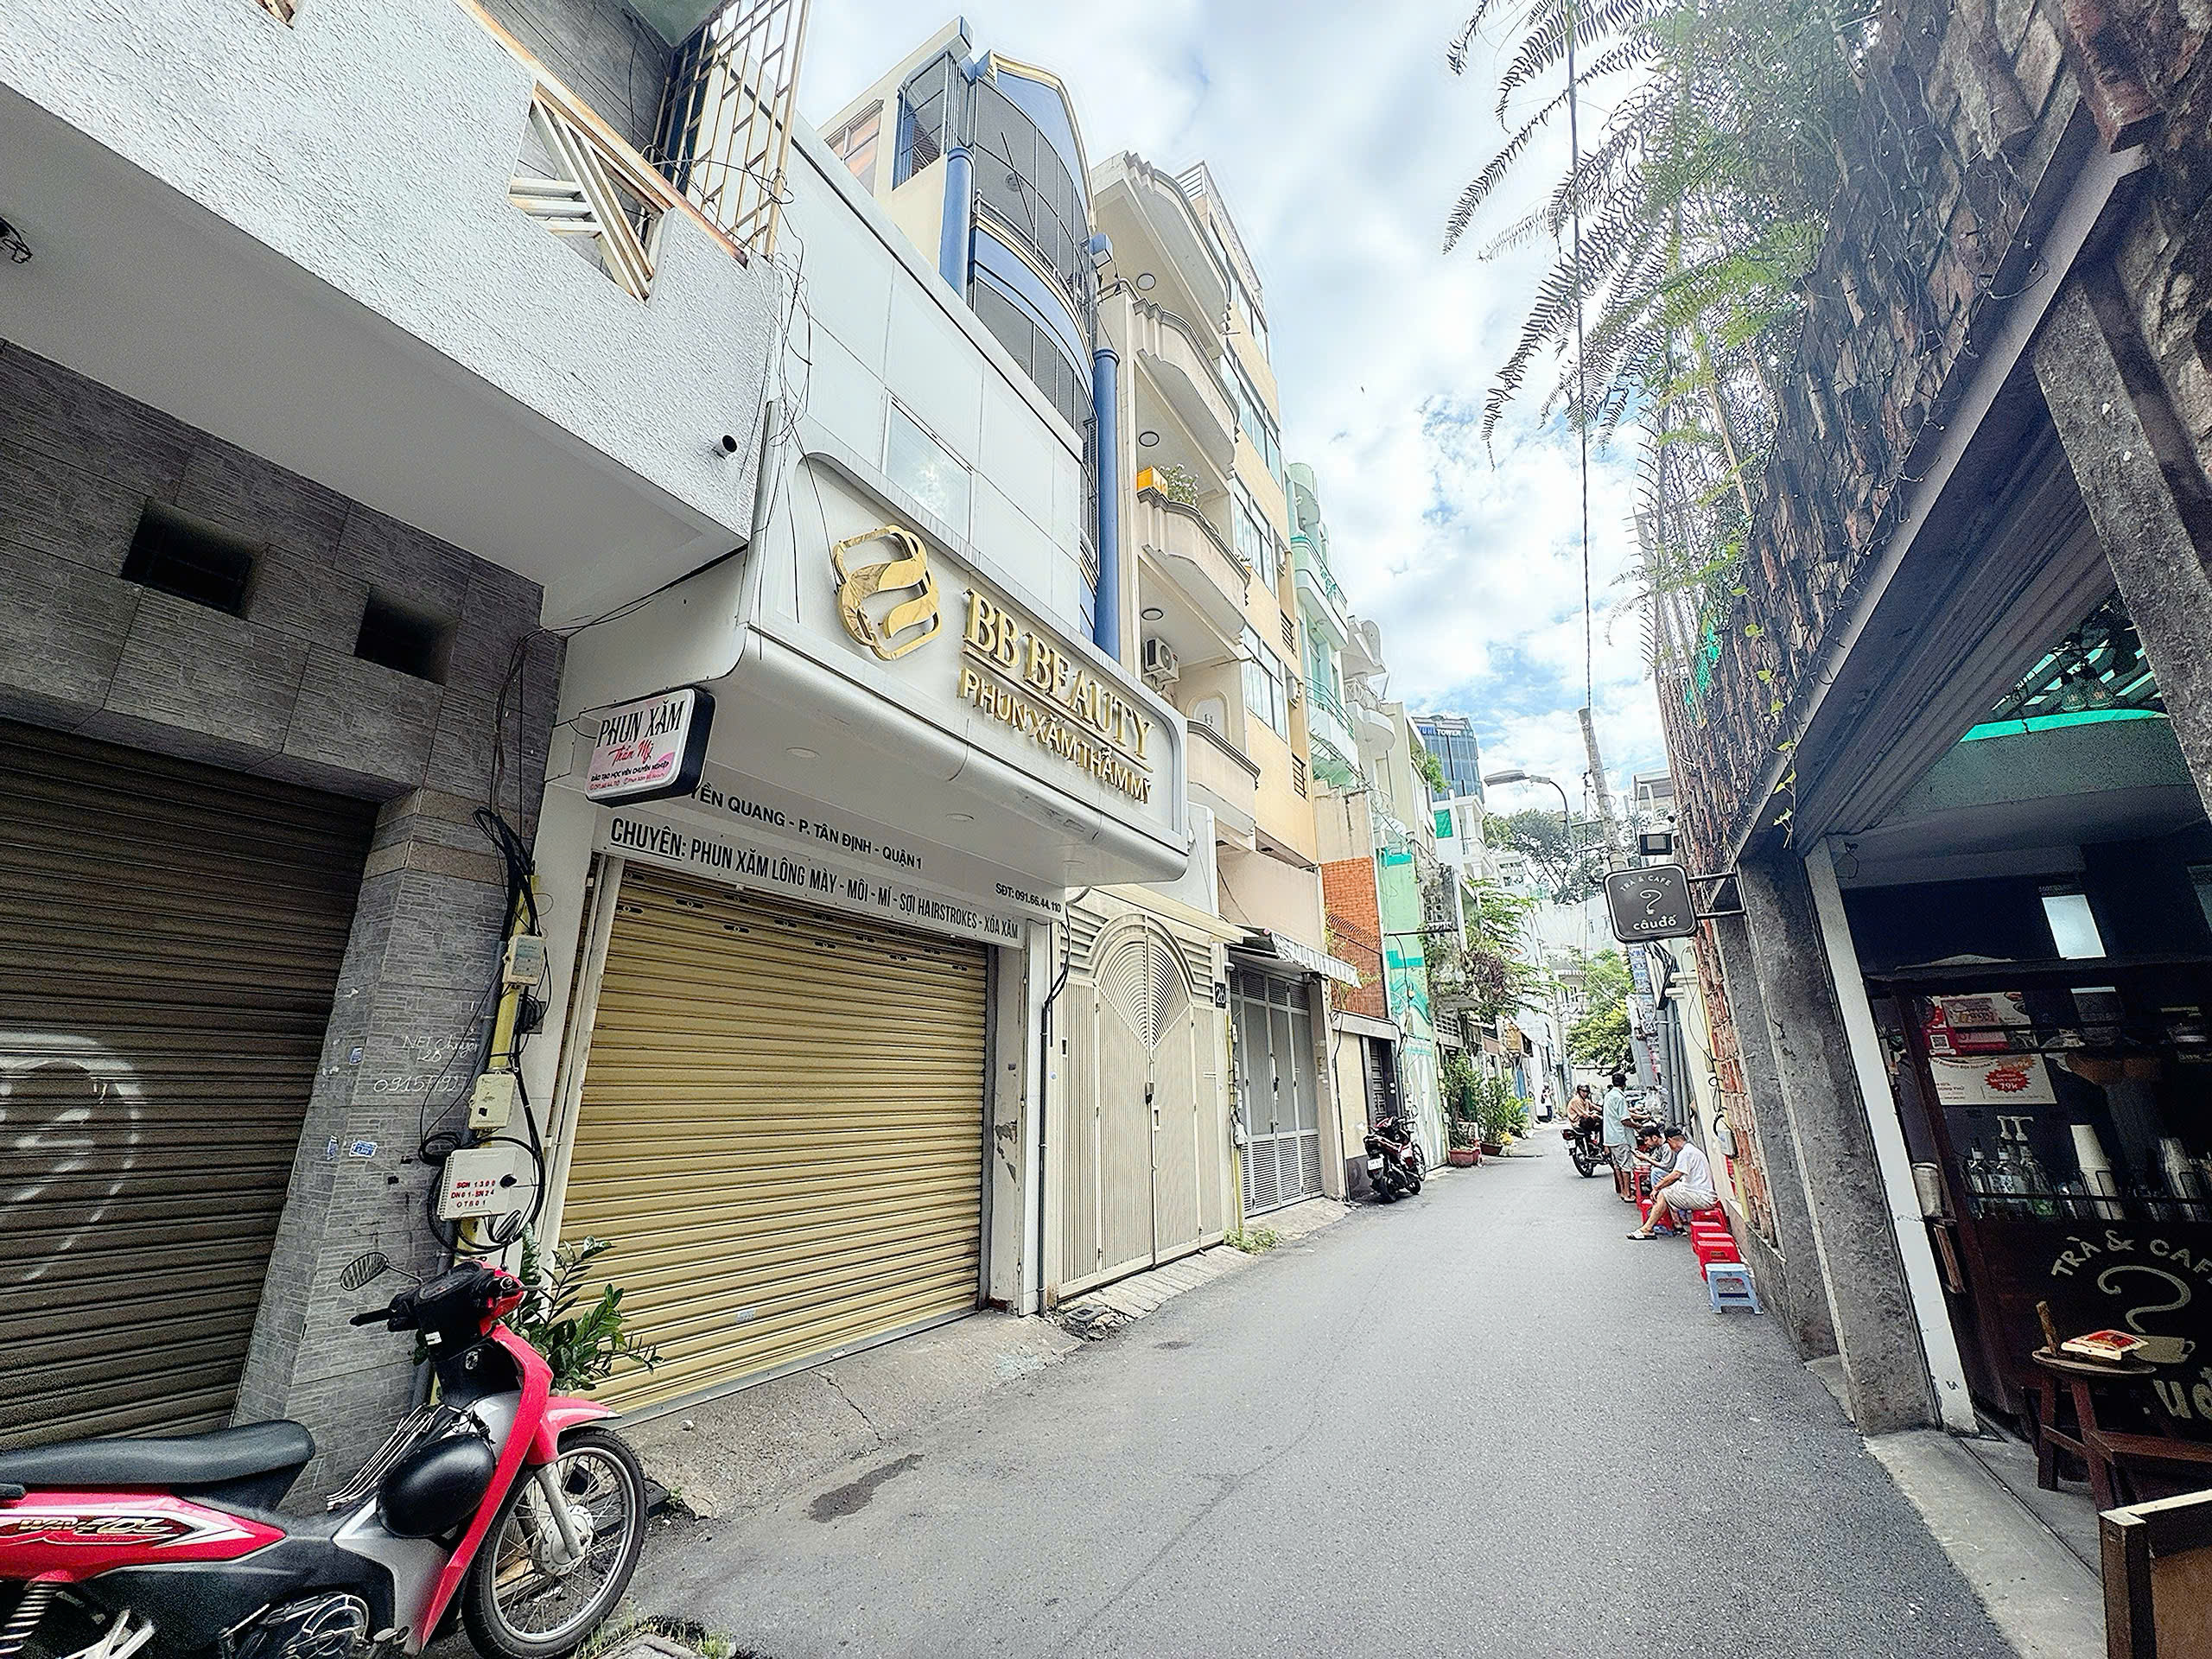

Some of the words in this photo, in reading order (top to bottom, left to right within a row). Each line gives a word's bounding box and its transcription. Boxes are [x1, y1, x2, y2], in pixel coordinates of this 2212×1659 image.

[963, 588, 1020, 669] BB
[1024, 631, 1155, 760] BEAUTY
[596, 711, 644, 748] PHUN
[645, 700, 685, 737] XĂM
[957, 667, 1028, 732] PHUN
[1028, 709, 1078, 762] XĂM
[728, 797, 785, 828] QUANG
[798, 819, 810, 835] P.
[813, 823, 839, 844] TÂN
[842, 836, 872, 855] ĐỊNH
[882, 846, 915, 868] QUẬN
[611, 817, 686, 858] CHUYÊN:
[690, 838, 733, 869] PHUN
[735, 849, 768, 878] XĂM
[772, 857, 805, 886] LÔNG
[810, 868, 837, 894] MÀY
[847, 879, 868, 901] MÔI
[878, 886, 892, 907] MÍ
[899, 893, 915, 916] SỢI
[918, 899, 977, 929] HAIRSTROKES
[984, 916, 1001, 934] XÓA
[1001, 920, 1019, 939] XĂM
[995, 882, 1014, 899] SĐT:
[1632, 914, 1677, 931] câuđố
[1216, 986, 1226, 1004] 26
[2050, 1236, 2101, 1276] TRÀ
[2105, 1230, 2134, 1251] &
[2150, 1239, 2212, 1284] CAF
